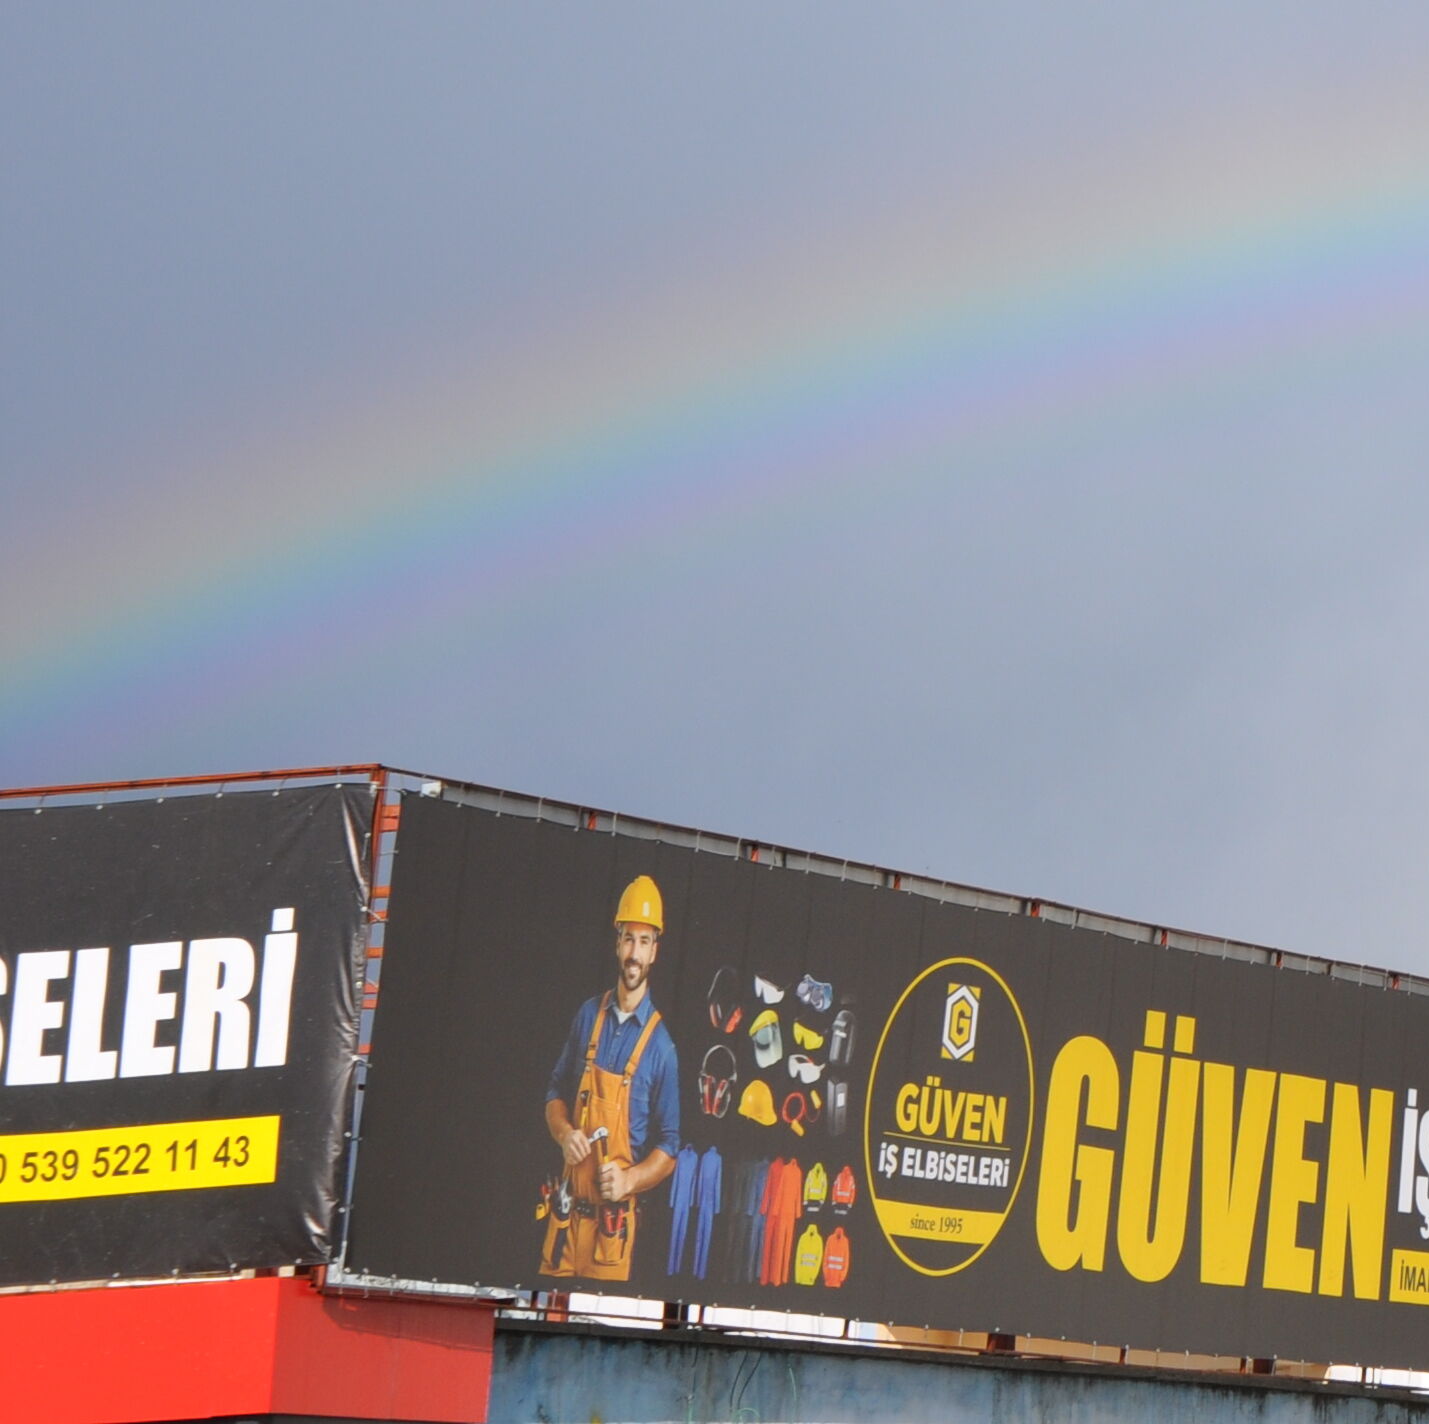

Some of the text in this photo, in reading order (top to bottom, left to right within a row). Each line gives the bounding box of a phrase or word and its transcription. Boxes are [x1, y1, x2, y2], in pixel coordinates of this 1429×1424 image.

[0, 907, 298, 1087] ELERİ
[895, 1075, 1007, 1144] GÜVEN
[20, 1148, 79, 1184] 539
[92, 1143, 151, 1179] 522
[165, 1138, 199, 1173] 11
[213, 1135, 251, 1169] 43
[1035, 1009, 1395, 1302] GÜVEN
[910, 1213, 964, 1235] since 1995
